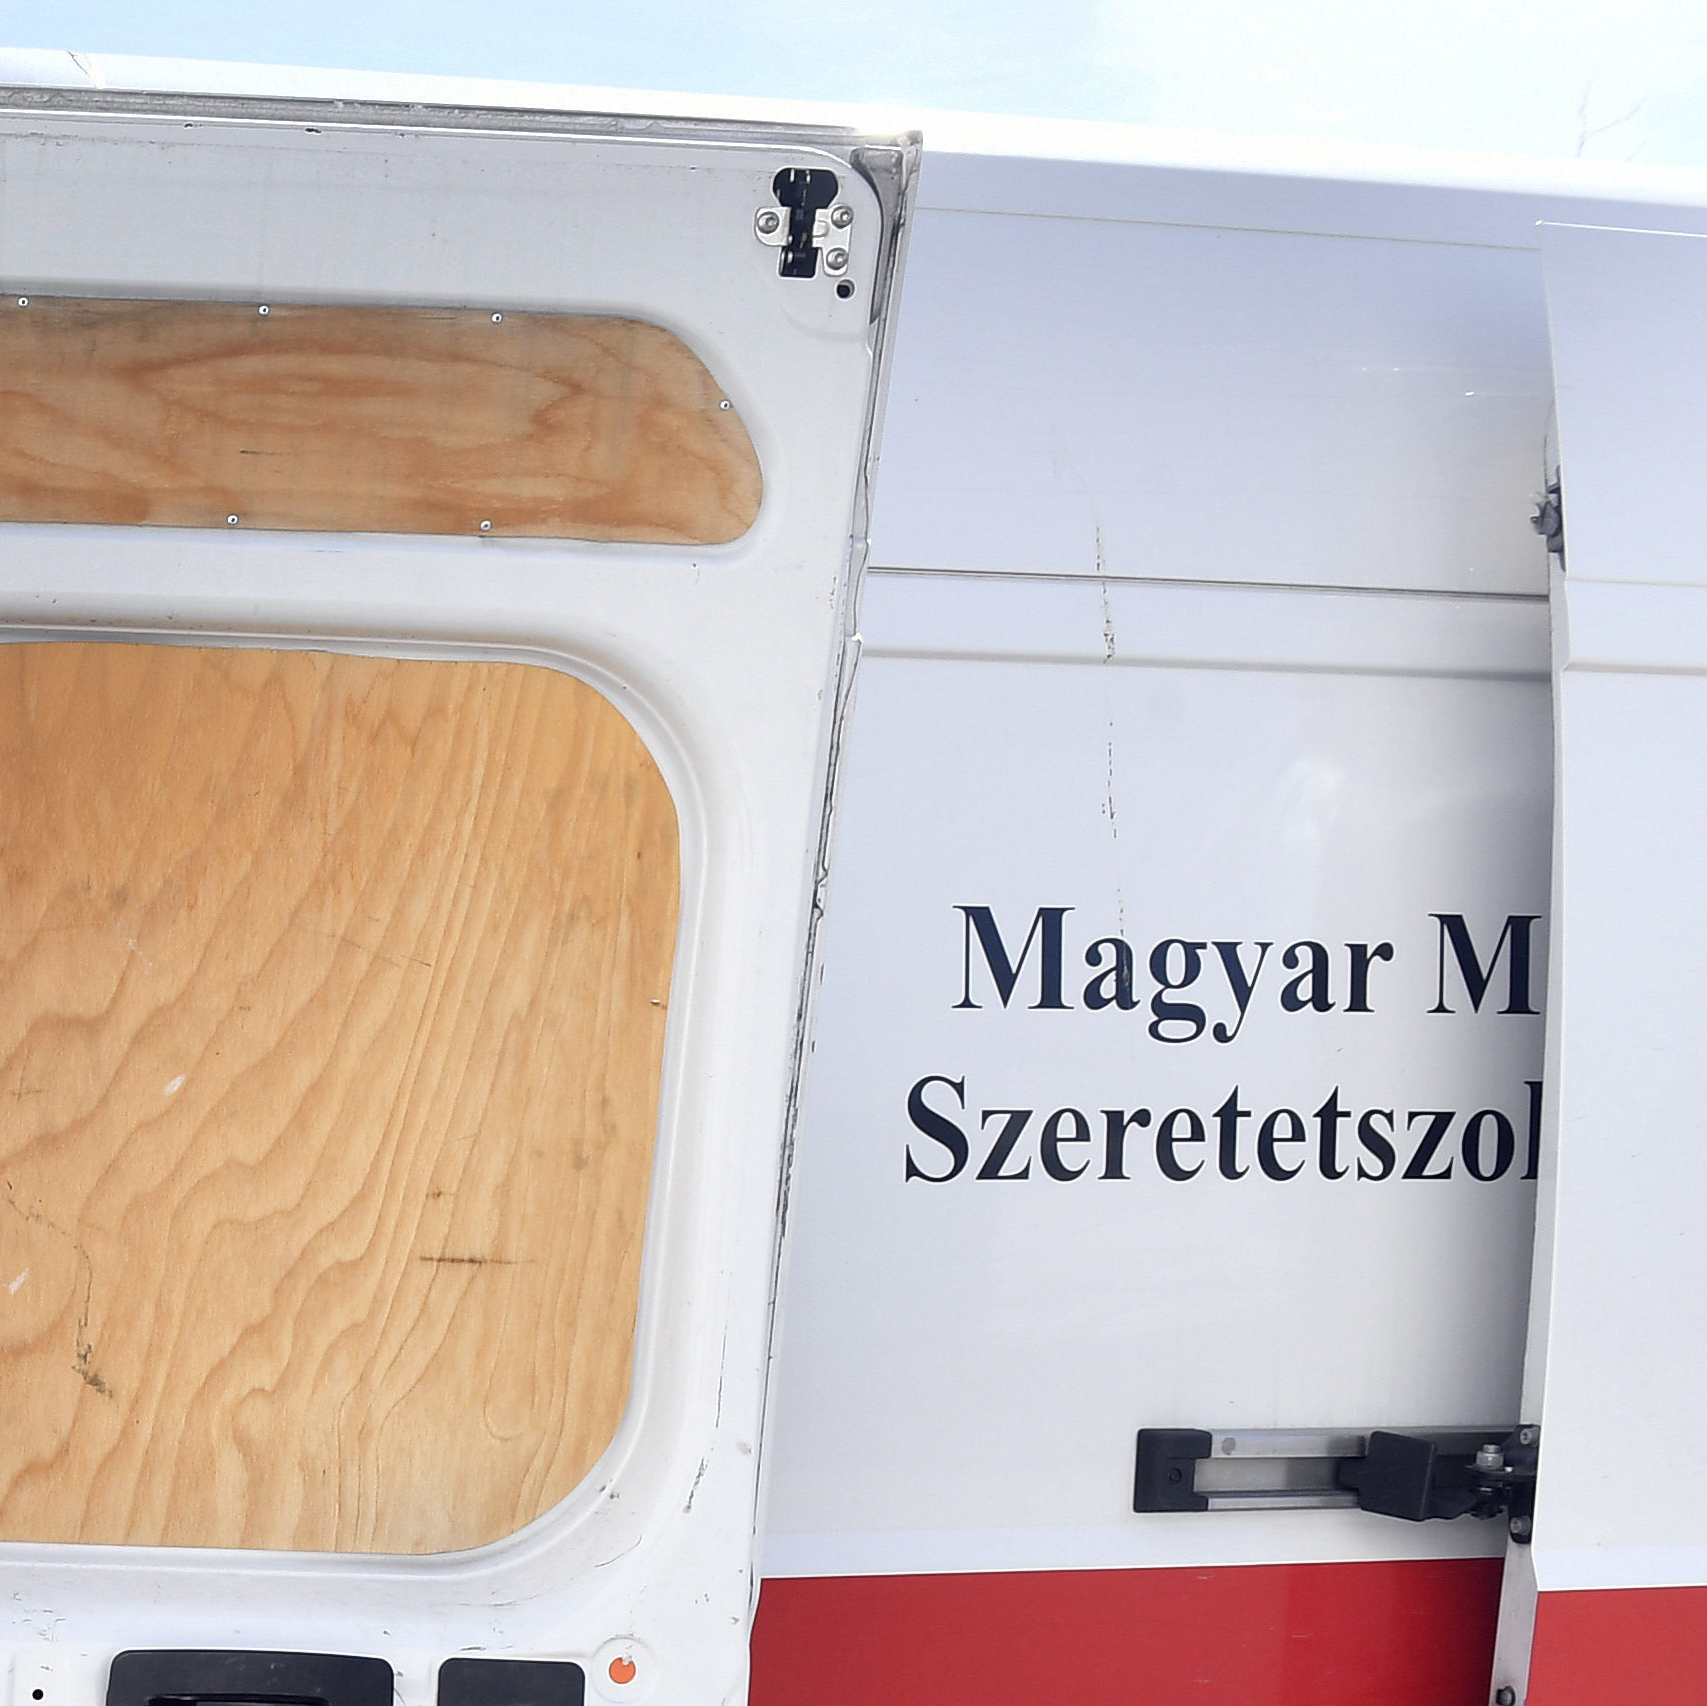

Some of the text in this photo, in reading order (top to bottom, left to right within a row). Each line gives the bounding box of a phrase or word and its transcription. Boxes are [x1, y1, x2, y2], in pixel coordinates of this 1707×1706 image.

[952, 903, 1543, 1045] Magyar M
[904, 1075, 1544, 1185] Szeretetszol
